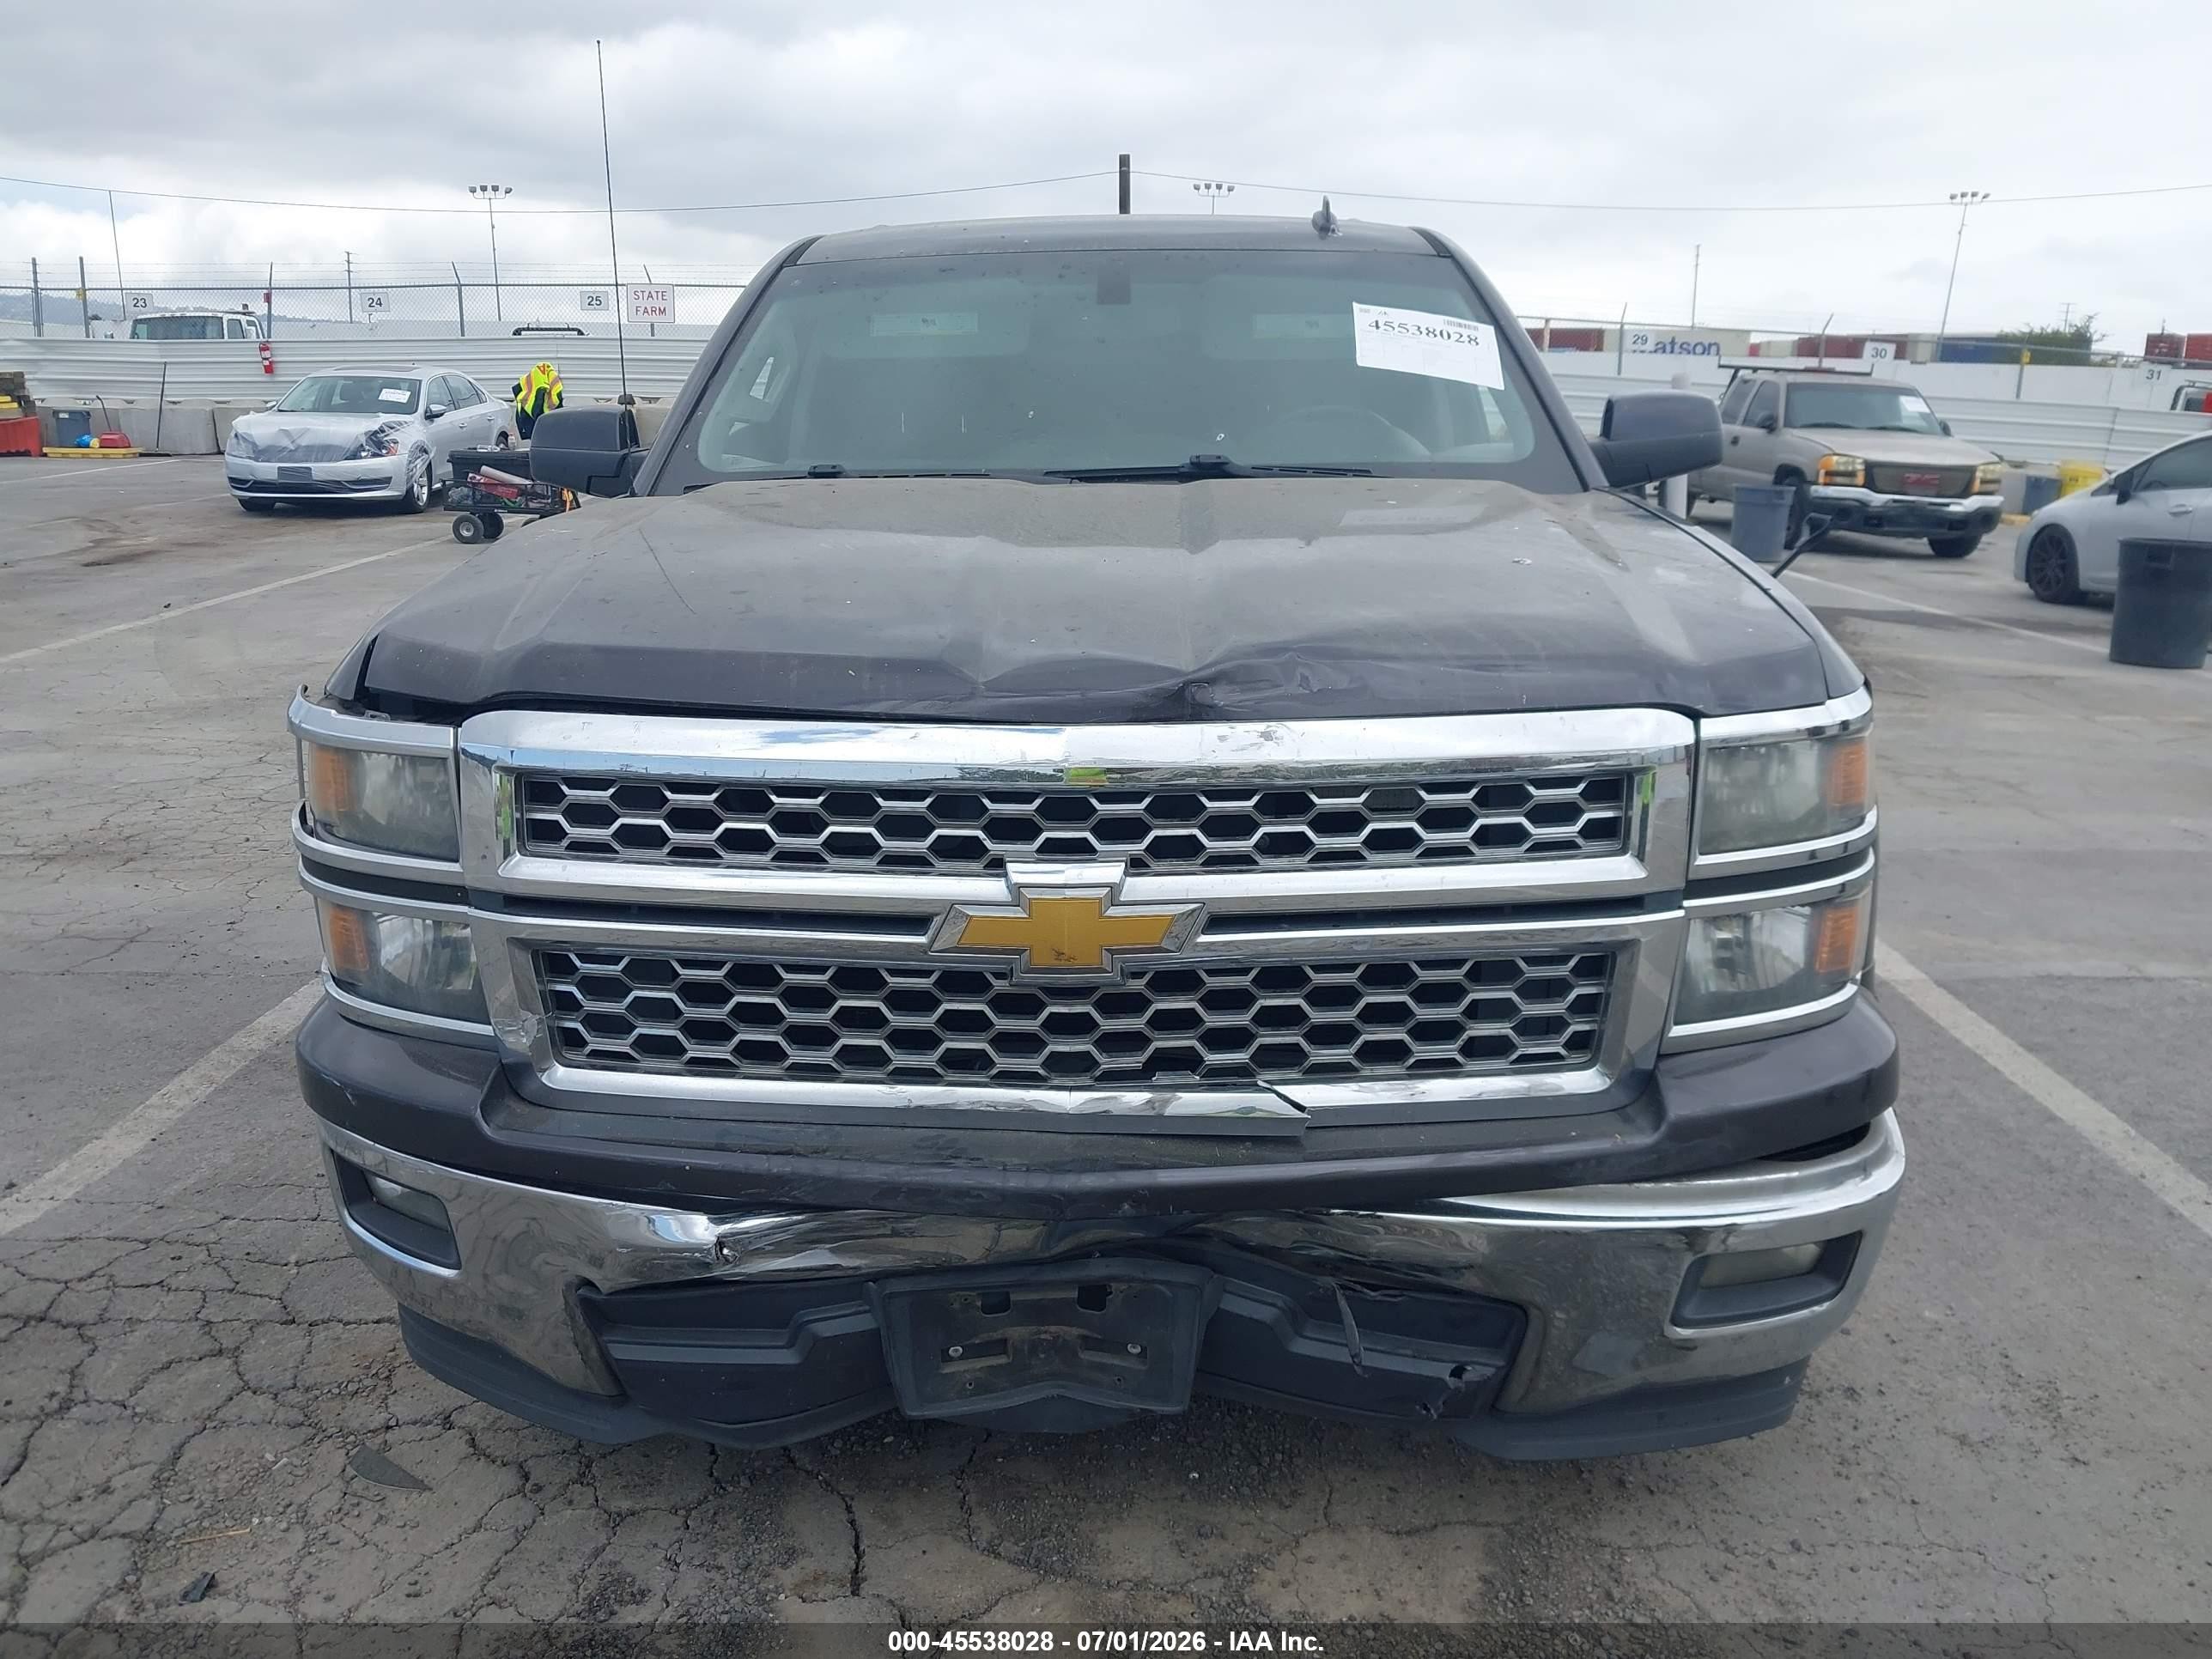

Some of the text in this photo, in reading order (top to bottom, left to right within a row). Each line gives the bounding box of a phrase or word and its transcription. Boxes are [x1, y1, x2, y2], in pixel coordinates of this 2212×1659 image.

[634, 290, 667, 301] STATE
[132, 297, 147, 308] 23
[368, 297, 382, 308] 24
[587, 296, 603, 307] 25
[635, 306, 666, 317] FARM
[1368, 319, 1480, 347] 45538028
[1632, 334, 1648, 345] 29
[1633, 336, 1720, 356] atson
[1871, 347, 1887, 359] 30
[2145, 369, 2162, 380] 31
